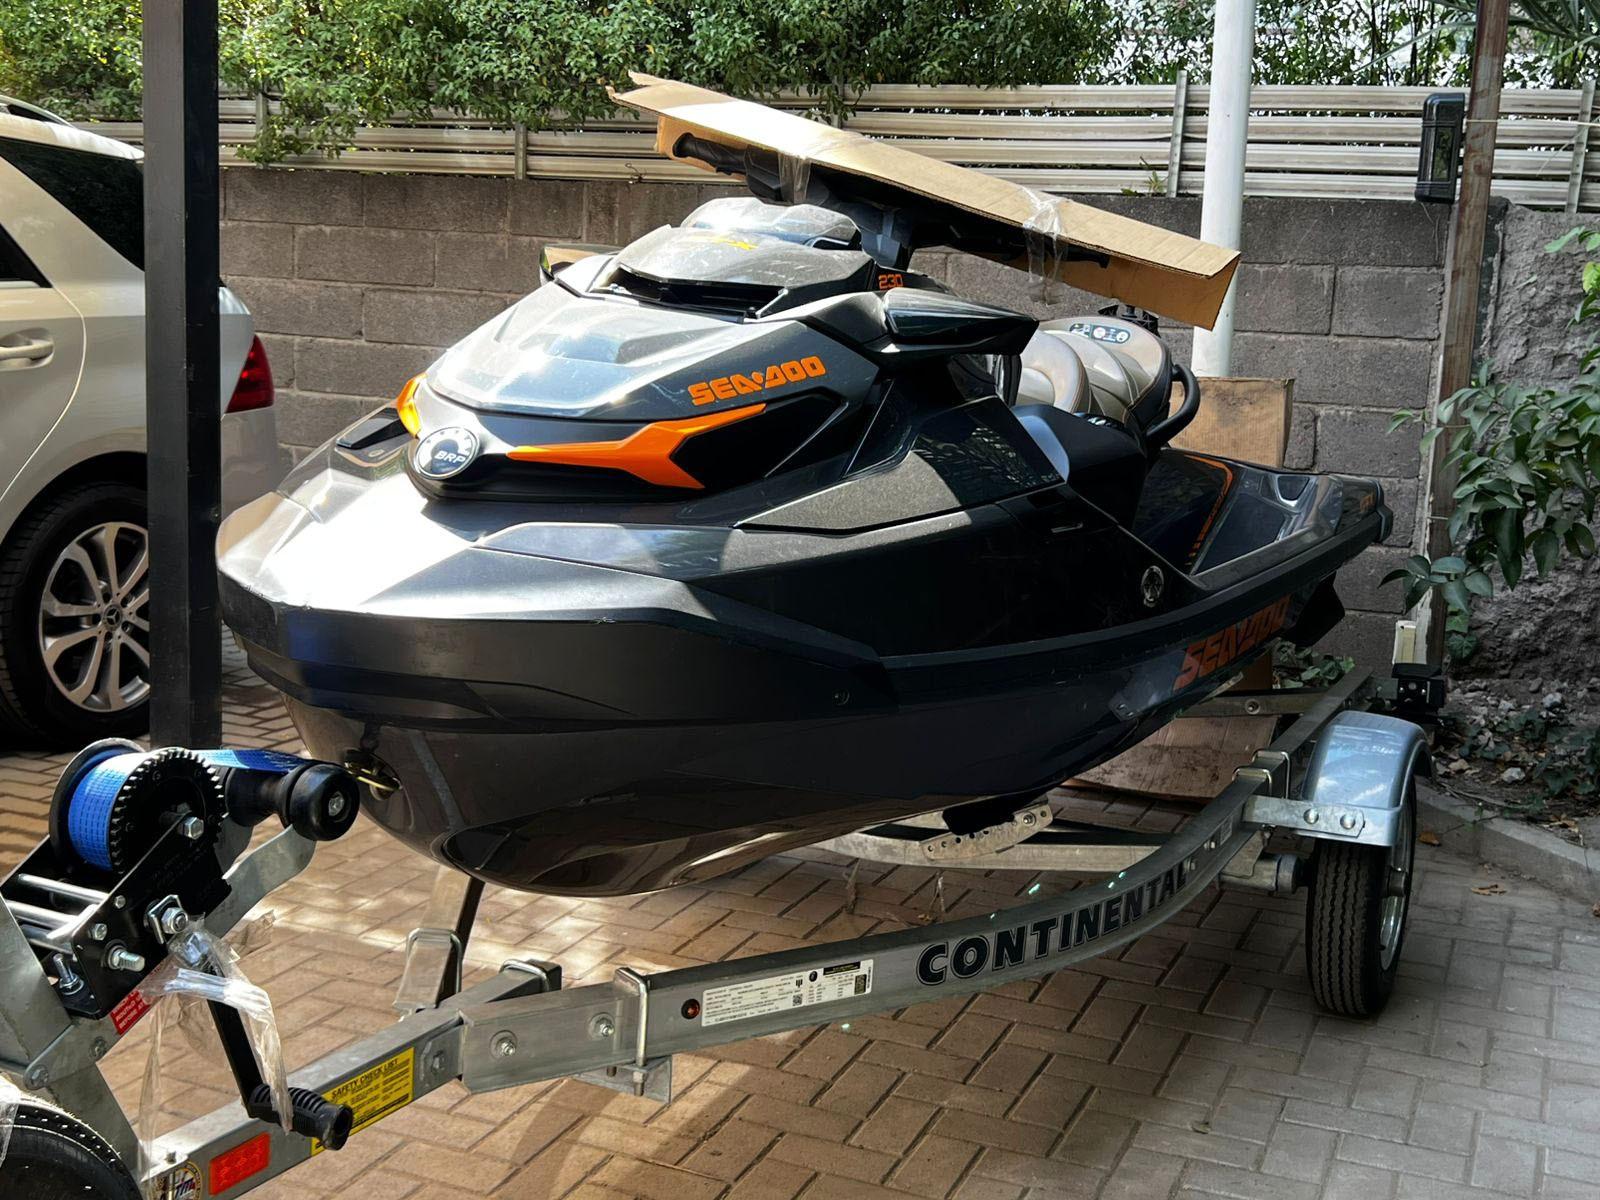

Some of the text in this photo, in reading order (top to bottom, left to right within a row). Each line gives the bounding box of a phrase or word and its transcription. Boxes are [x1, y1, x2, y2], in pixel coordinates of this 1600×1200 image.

[879, 274, 904, 290] 230
[434, 450, 467, 463] BRP
[916, 858, 1189, 986] CONTINENTAL
[332, 1078, 360, 1099] SAFETY
